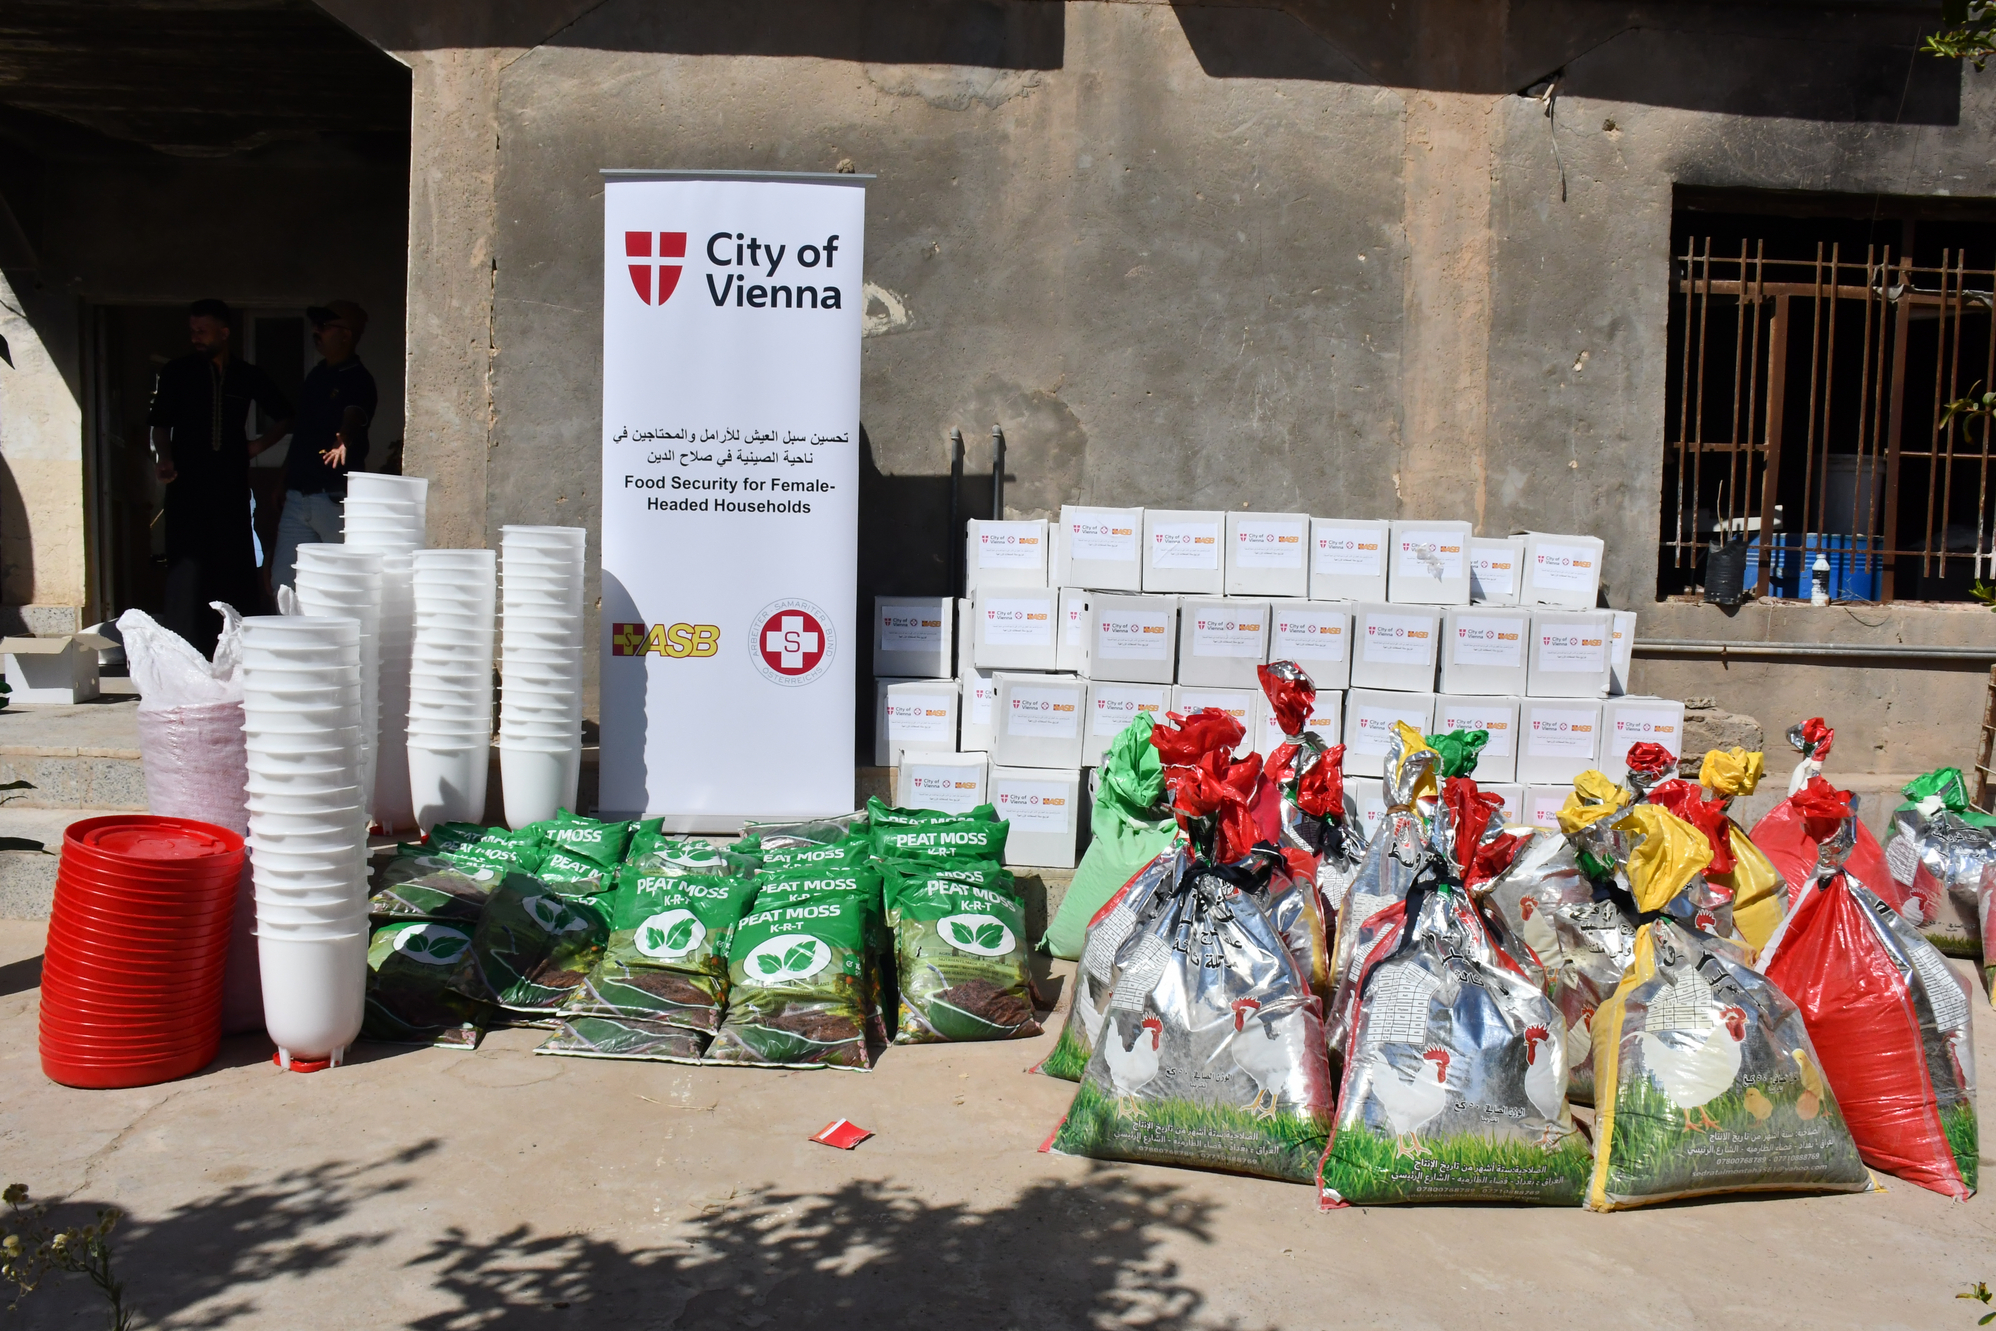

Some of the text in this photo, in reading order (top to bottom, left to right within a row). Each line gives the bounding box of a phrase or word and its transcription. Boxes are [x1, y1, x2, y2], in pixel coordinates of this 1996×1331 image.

[706, 232, 839, 277] City of
[706, 274, 841, 309] Vienna
[613, 426, 848, 445] تحسين سبل العيش للأرامل والمحتاجين في
[648, 449, 813, 467] ناحية الصينية في صلاح الدين
[625, 475, 836, 493] Food Security for Female-
[648, 497, 811, 513] Headed Households
[750, 601, 834, 657] ARBEITER SAMARITER BUND
[625, 622, 720, 658] S ASB
[784, 631, 800, 653] S
[762, 666, 823, 684] ÖSTERREICHS
[556, 829, 603, 842] MOSS
[896, 832, 988, 847] PEAT MOSS
[763, 849, 845, 863] EAT MOSS
[550, 854, 591, 874] PEAT
[637, 877, 730, 899] PEAT MOSS
[804, 879, 857, 891] MOSS
[664, 894, 691, 906] K-R-T
[927, 880, 1016, 912] PEAT MOSS
[961, 901, 992, 911] K-R-T
[738, 905, 841, 931] PEAT MOSS
[770, 922, 804, 933] K-R-T
[1508, 1107, 1526, 1118] الوزن
[1132, 1120, 1154, 1130] الإنتاج
[1155, 1124, 1174, 1134] تاريخ
[1175, 1126, 1186, 1135] من
[1143, 1135, 1166, 1145] الشارع
[1709, 1132, 1730, 1143] الإنتاج
[1732, 1132, 1750, 1143] تاريخ
[1751, 1134, 1762, 1143] من
[1229, 1144, 1248, 1154] بغداد
[1715, 1145, 1739, 1156] الشارع
[1716, 1153, 1820, 1165] 07800768789 07710888769
[1414, 1160, 1438, 1171] الإنتاج
[1440, 1162, 1459, 1173] تاريخ
[1461, 1163, 1473, 1173] من
[1474, 1163, 1495, 1174] أشهر
[1391, 1172, 1423, 1181] الرئيسي
[1424, 1174, 1450, 1185] الشارع
[1515, 1177, 1535, 1187] بغداد
